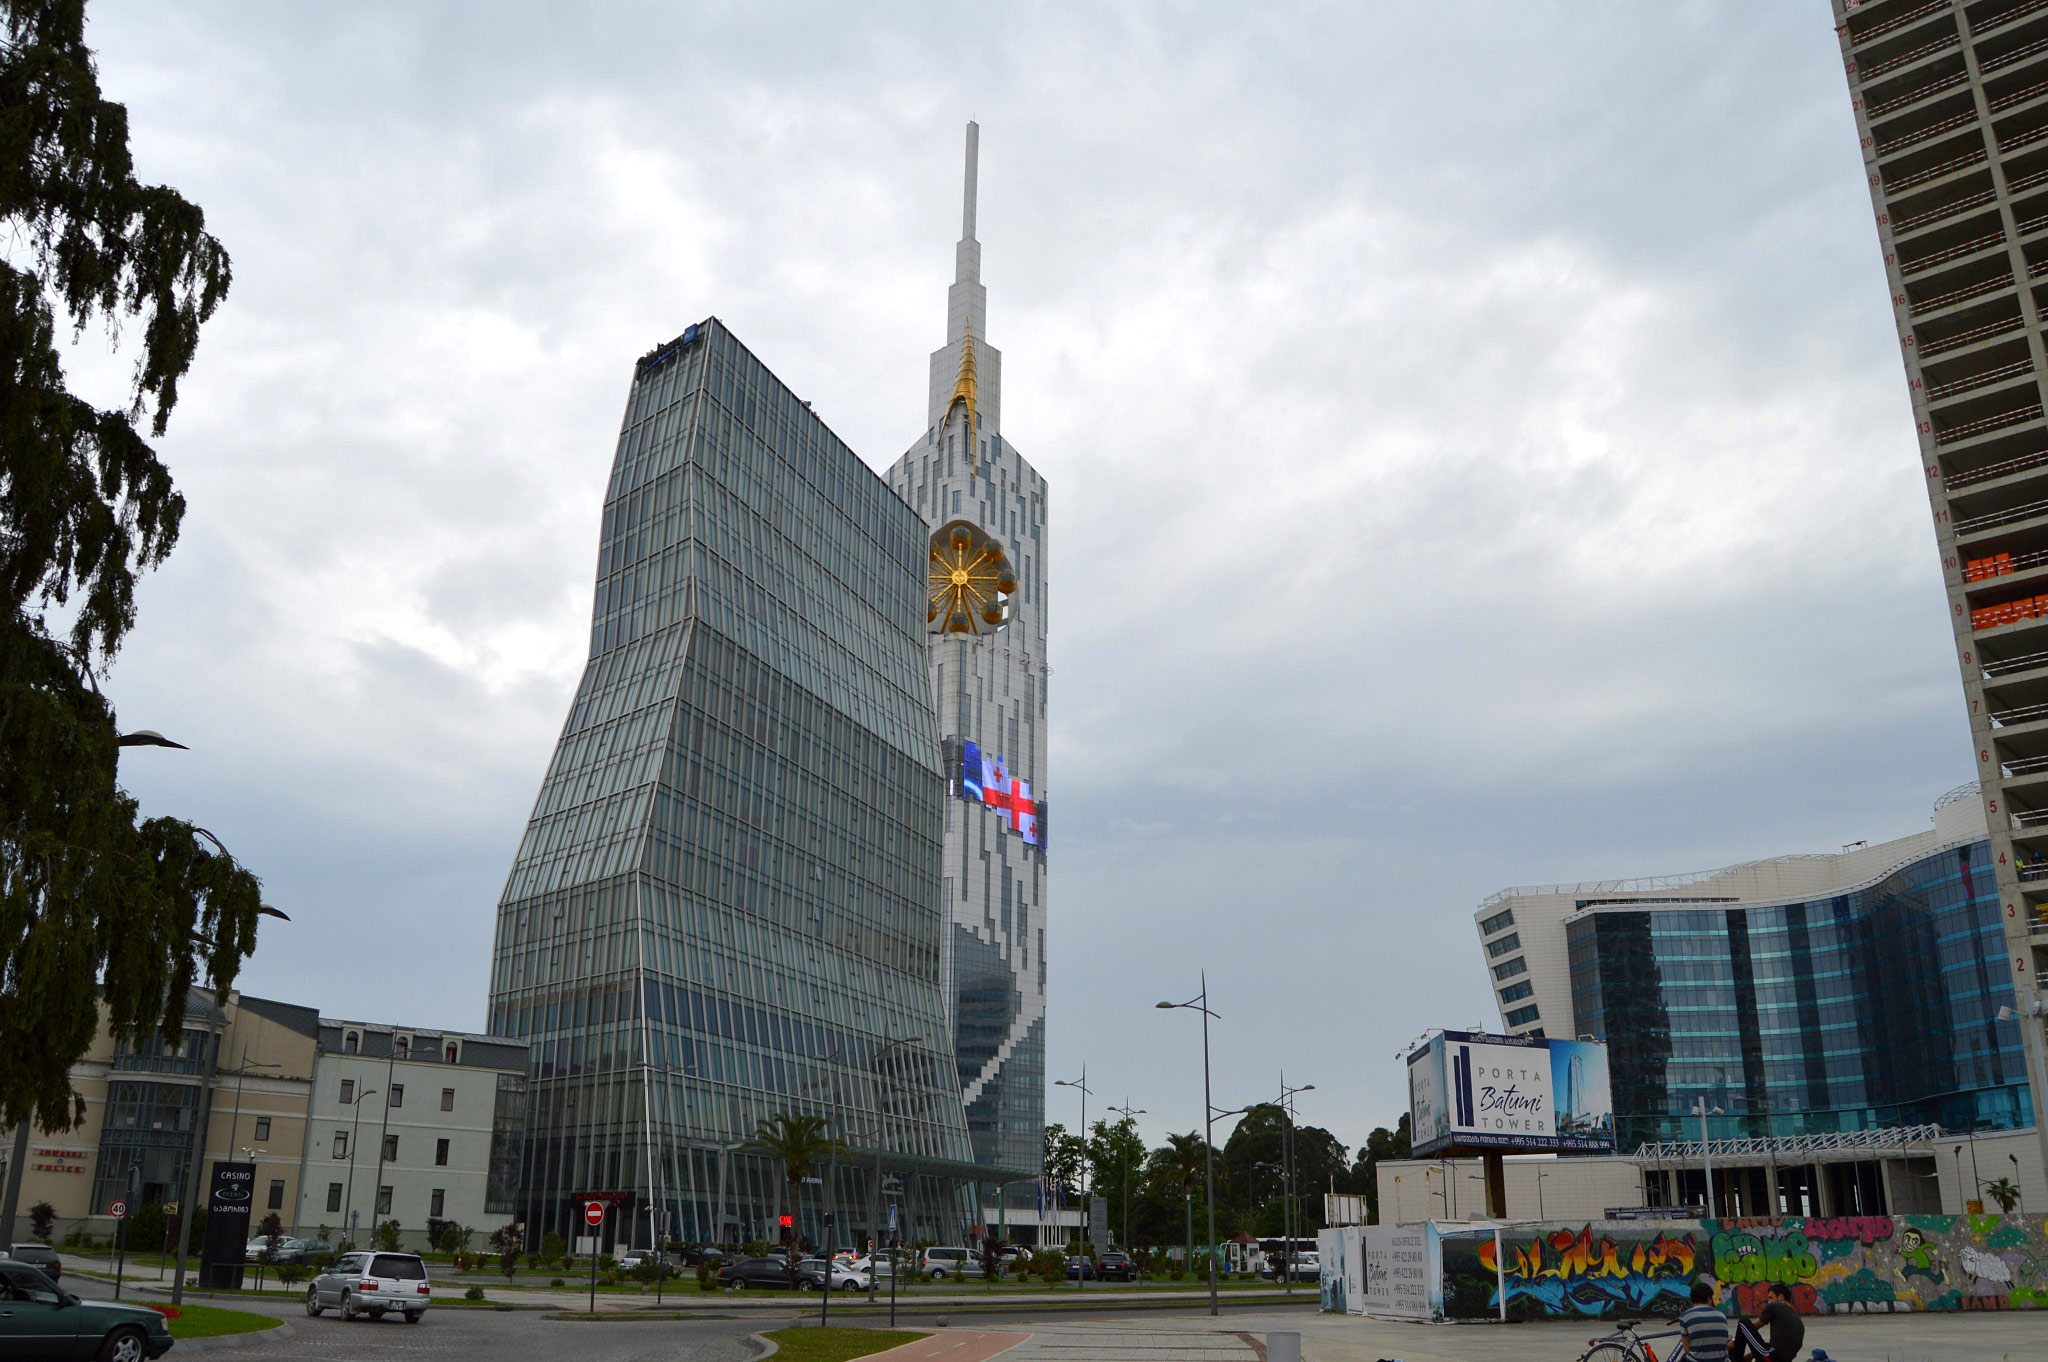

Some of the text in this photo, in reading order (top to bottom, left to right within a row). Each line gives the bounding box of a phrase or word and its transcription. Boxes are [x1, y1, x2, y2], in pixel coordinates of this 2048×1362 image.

[1845, 62, 1857, 75] 22
[1853, 98, 1864, 112] 21
[1861, 136, 1873, 150] 20
[1869, 175, 1881, 187] 19
[1876, 214, 1889, 226] 18
[1885, 254, 1896, 266] 17
[1893, 294, 1906, 307] 16
[1901, 335, 1914, 348] 15
[1909, 377, 1923, 390] 14
[1918, 422, 1931, 434] 13
[1926, 466, 1939, 479] 12
[1935, 509, 1949, 523] 11
[1944, 556, 1957, 570] 10
[1955, 604, 1963, 616] 9
[1963, 651, 1972, 665] 8
[1972, 700, 1979, 713] 7
[1981, 749, 1990, 763] 6
[1989, 800, 1998, 813] 5
[1998, 851, 2007, 865] 4
[2007, 903, 2016, 918] 3
[2015, 957, 2025, 972] 2
[1478, 1067, 1541, 1082] PORTA
[1480, 1084, 1543, 1116] Batumi
[1482, 1117, 1544, 1131] TOWER
[1511, 1137, 1525, 1146] +995
[1526, 1138, 1537, 1146] 514
[1538, 1138, 1548, 1147] 222
[1549, 1138, 1559, 1147] 333
[1563, 1138, 1577, 1148] +995
[1578, 1139, 1588, 1148] 514
[1600, 1140, 1610, 1149] 999
[37, 1164, 81, 1173] POLICE
[221, 1171, 251, 1180] CASINO
[113, 1205, 125, 1213] 40
